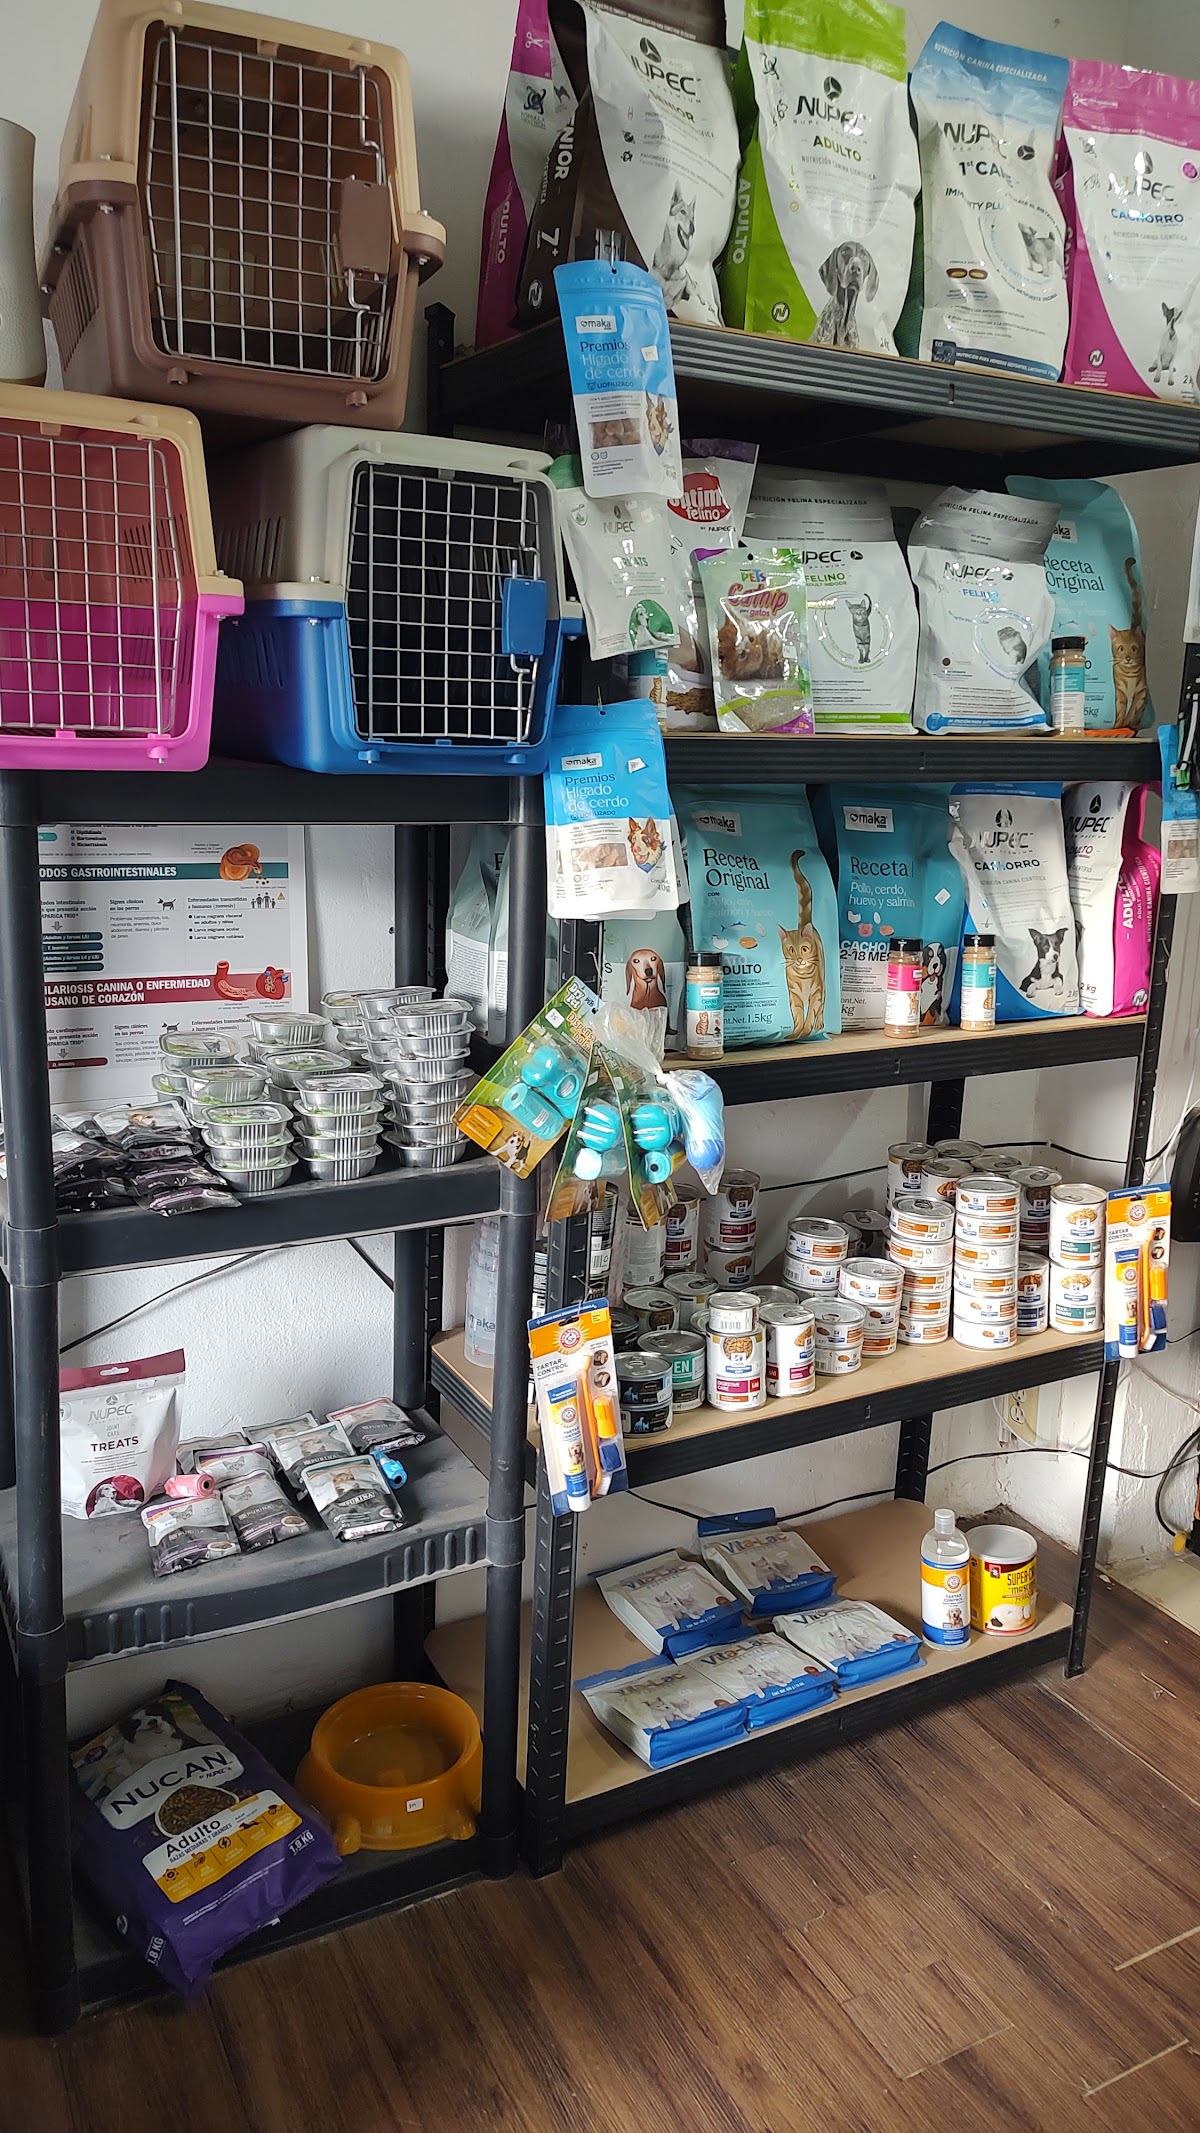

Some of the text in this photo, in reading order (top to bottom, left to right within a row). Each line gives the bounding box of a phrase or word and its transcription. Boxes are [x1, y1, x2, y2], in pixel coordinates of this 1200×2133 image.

[934, 42, 1048, 83] NUTRICIÓN CANINA ESPECIALIZADA
[554, 118, 575, 181] NIOR
[813, 135, 862, 162] ADULTO
[802, 156, 832, 166] NUTRICIÓN
[733, 178, 751, 265] ADULTO
[580, 341, 630, 352] Premios
[582, 353, 628, 367] Hígado
[585, 364, 644, 380] de cerdo
[686, 506, 720, 520] felino
[968, 507, 992, 516] FELINA
[992, 512, 1039, 525] ESPECIALIZADA
[604, 521, 636, 534] NUPEC
[1044, 554, 1095, 574] Receta
[740, 568, 766, 583] PETS
[805, 572, 845, 582] FELINO
[1046, 571, 1105, 593] Original
[728, 583, 788, 614] Catnip
[749, 608, 770, 618] gatos
[565, 772, 616, 786] Premios
[566, 784, 612, 800] Hígado
[568, 795, 630, 812] de cerdo
[1066, 816, 1110, 834] NUPEC
[704, 848, 761, 871] Receta
[850, 856, 909, 878] Receta
[70, 866, 176, 878] GASTROINTESTINALES
[706, 868, 771, 892] Original
[850, 882, 907, 896] Pollo, cerdo,
[848, 894, 877, 908] huevo
[1118, 873, 1133, 929] ADULTO
[722, 964, 762, 976] DULTO
[44, 978, 211, 996] ILARIOSIS CANINA O ENFERMEDAD
[1086, 984, 1097, 994] kg
[45, 992, 144, 1006] USANO DE CORAZÓN
[748, 1012, 772, 1024] 1.5kg
[1108, 1232, 1133, 1241] CONTROL
[536, 1358, 562, 1372] TARTAR
[537, 1362, 569, 1378] CONTROL
[88, 1404, 134, 1422] NUPEC
[106, 1424, 120, 1432] JOINT
[108, 1430, 120, 1438] CARE
[90, 1436, 140, 1452] TREATS
[311, 1454, 338, 1465] PURINA
[345, 1492, 373, 1507] PURINA
[700, 1638, 770, 1665] Vita-Lac
[206, 1768, 226, 1779] NUPEC
[110, 1751, 228, 1815] NUCAN
[166, 1820, 221, 1858] Adulto
[170, 1852, 185, 1864] RAZAS
[185, 1838, 208, 1856] MEDIANAS
[212, 1823, 233, 1839] GRANDES
[302, 1831, 314, 1845] KG
[153, 1936, 164, 1952] KG
